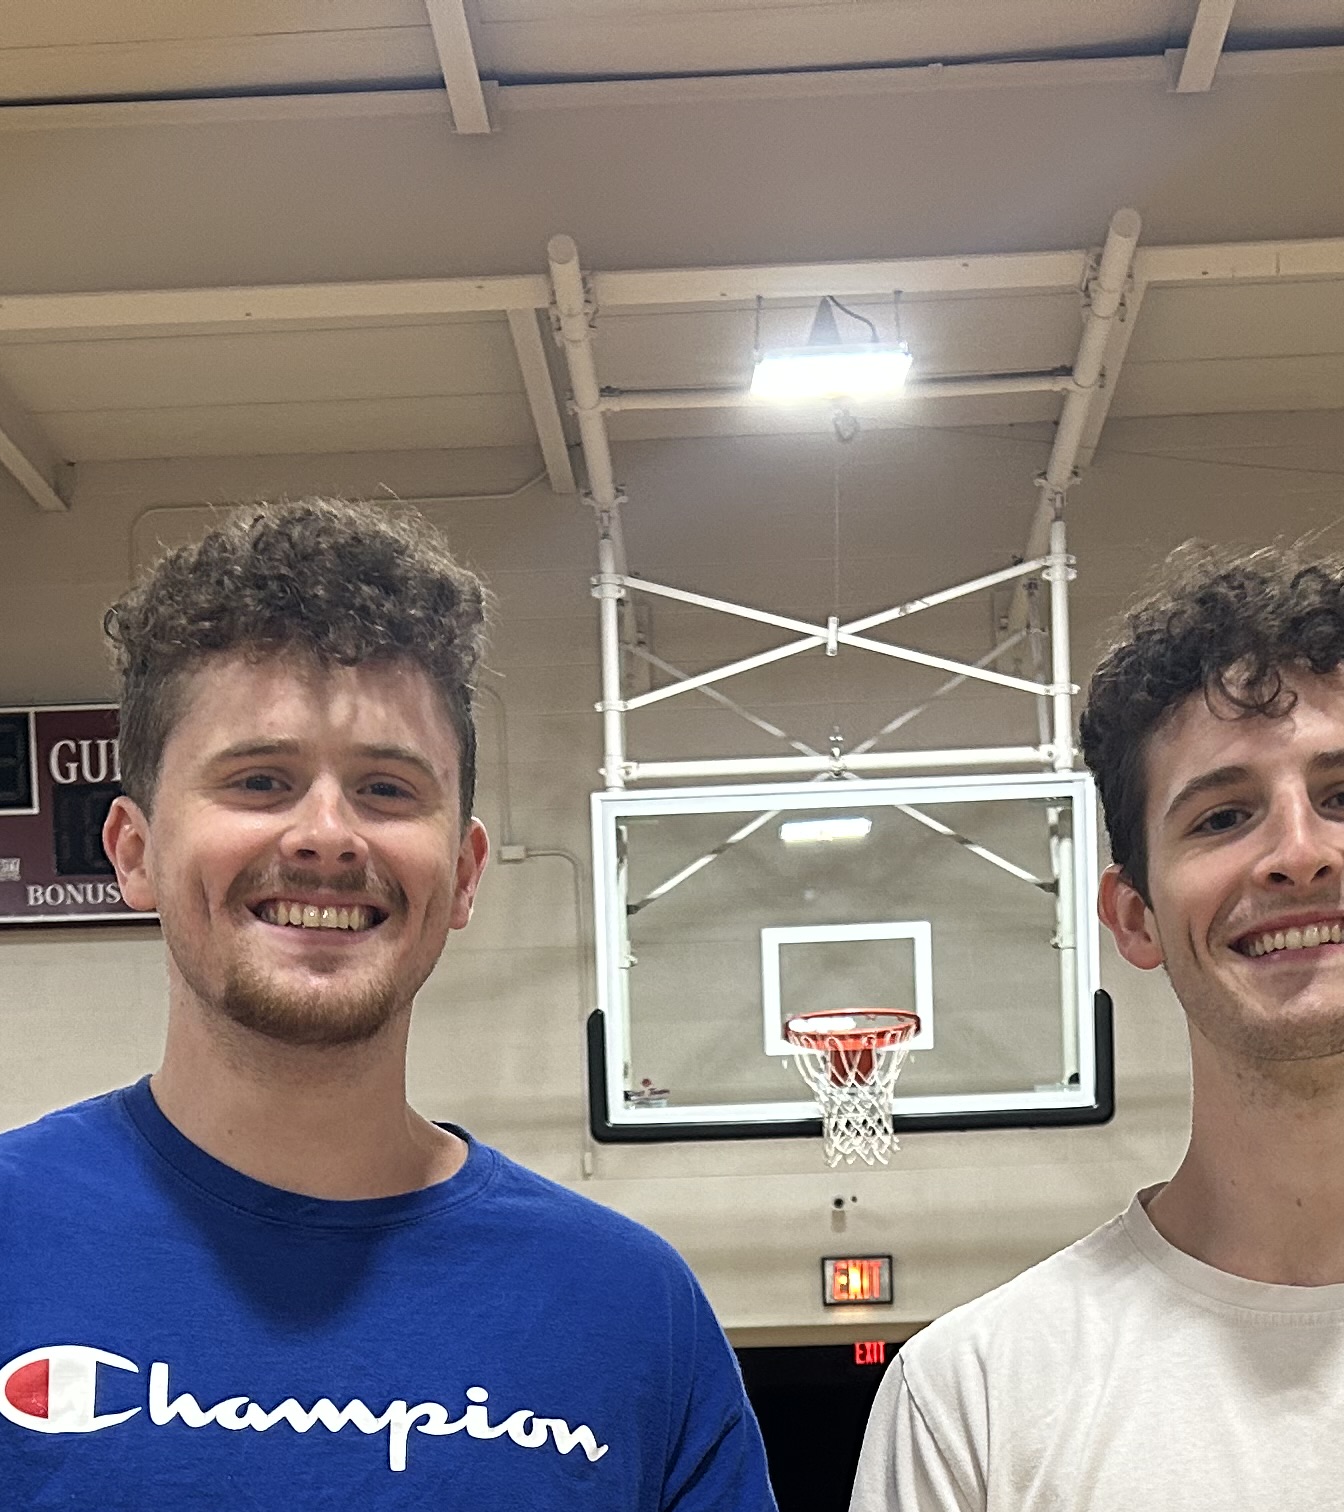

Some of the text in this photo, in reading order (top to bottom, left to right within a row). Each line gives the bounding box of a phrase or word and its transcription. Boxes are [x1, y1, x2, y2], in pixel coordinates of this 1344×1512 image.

[27, 882, 121, 908] BONUS
[834, 1260, 881, 1300] EXIT
[855, 1341, 885, 1364] EXIT
